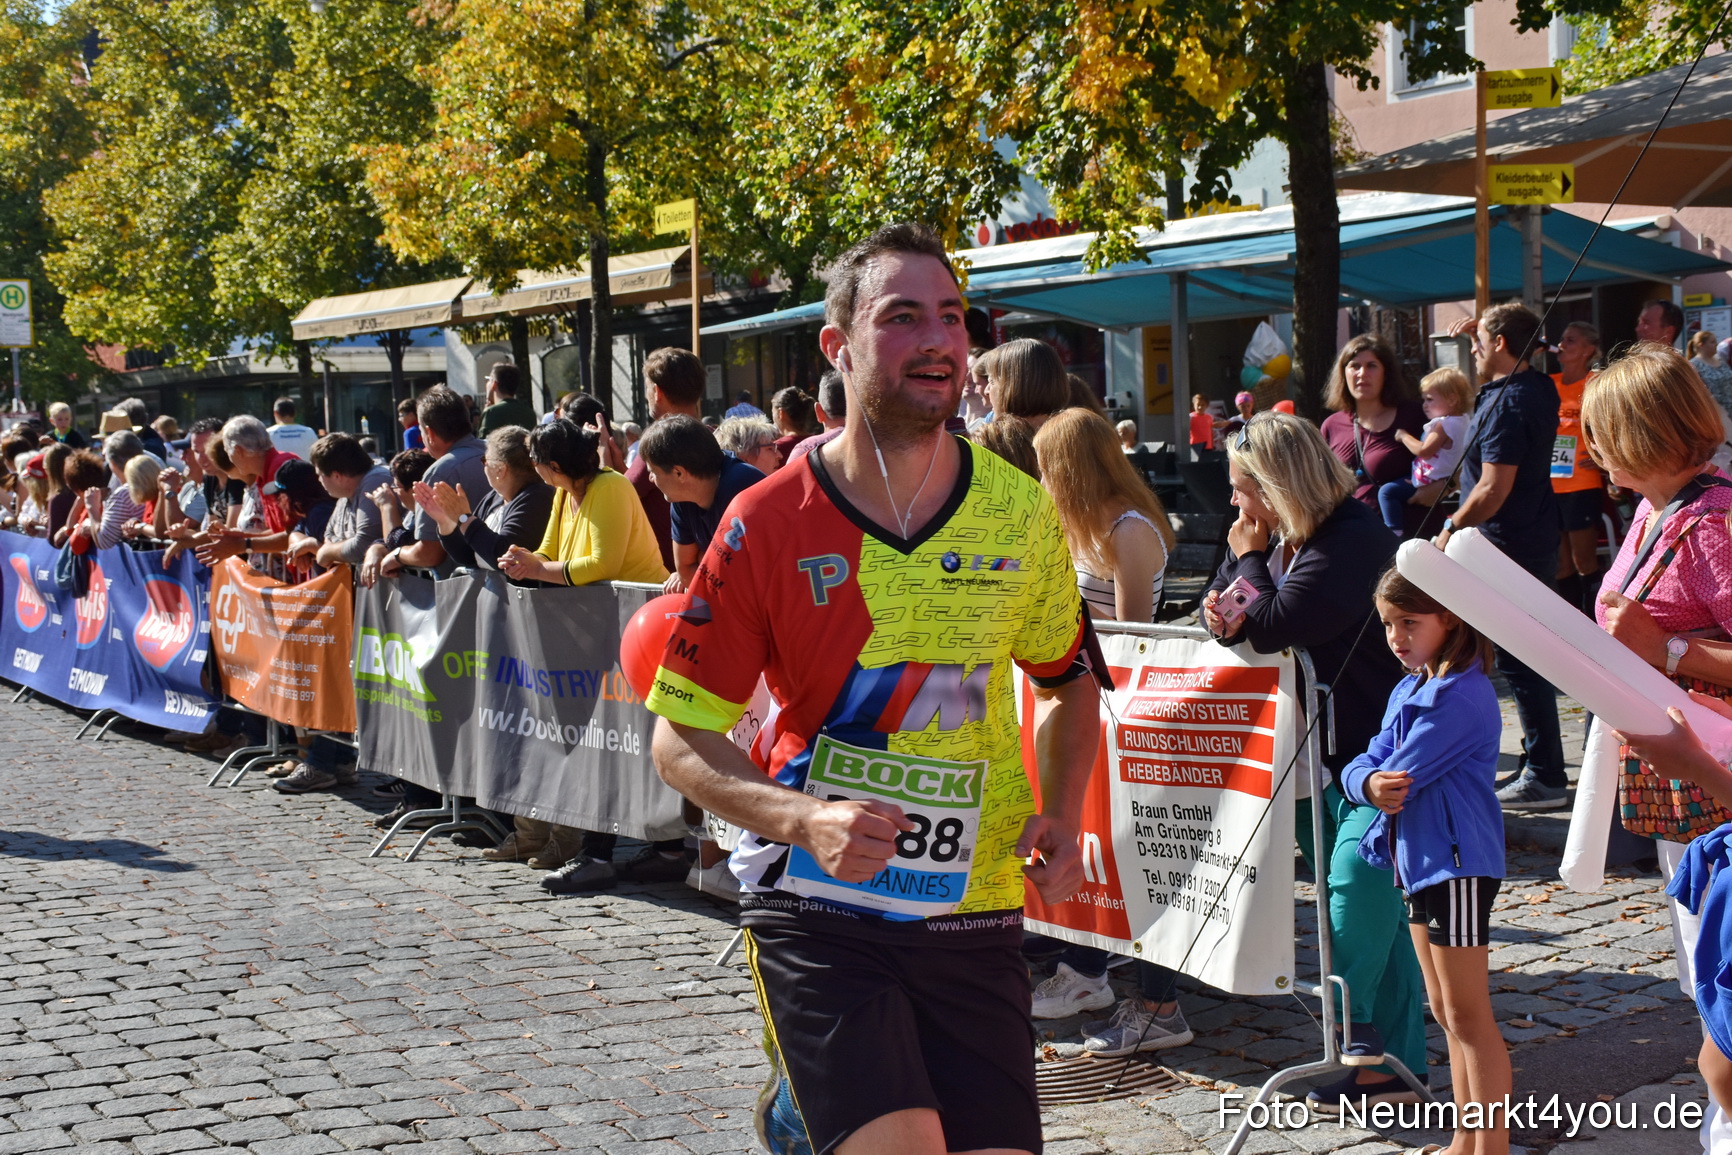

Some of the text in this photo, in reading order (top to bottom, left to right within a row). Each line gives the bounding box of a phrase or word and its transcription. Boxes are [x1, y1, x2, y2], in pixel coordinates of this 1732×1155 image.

[1496, 91, 1533, 107] ausgabe
[1496, 171, 1556, 184] Kleiderbeutel-
[1507, 186, 1543, 199] ausgabe
[662, 210, 692, 225] Toiletten
[653, 676, 696, 702] rsport
[1145, 671, 1215, 688] BINDESTRICKE
[1130, 701, 1249, 721] VERZURRSYSTEME
[1125, 730, 1242, 753] RUNDSCHLINGEN
[829, 752, 971, 798] BOCK
[1128, 763, 1223, 784] HEBEBÄNDER
[1132, 801, 1212, 822] Braun GmbH
[1135, 821, 1222, 847] Am Grünberg 8
[1137, 841, 1187, 860] D-92318
[1143, 869, 1166, 885] Tel.
[1168, 871, 1197, 891] 09181
[1093, 893, 1126, 910] sicher
[1147, 888, 1168, 905] Fax
[1171, 892, 1195, 912] 09181
